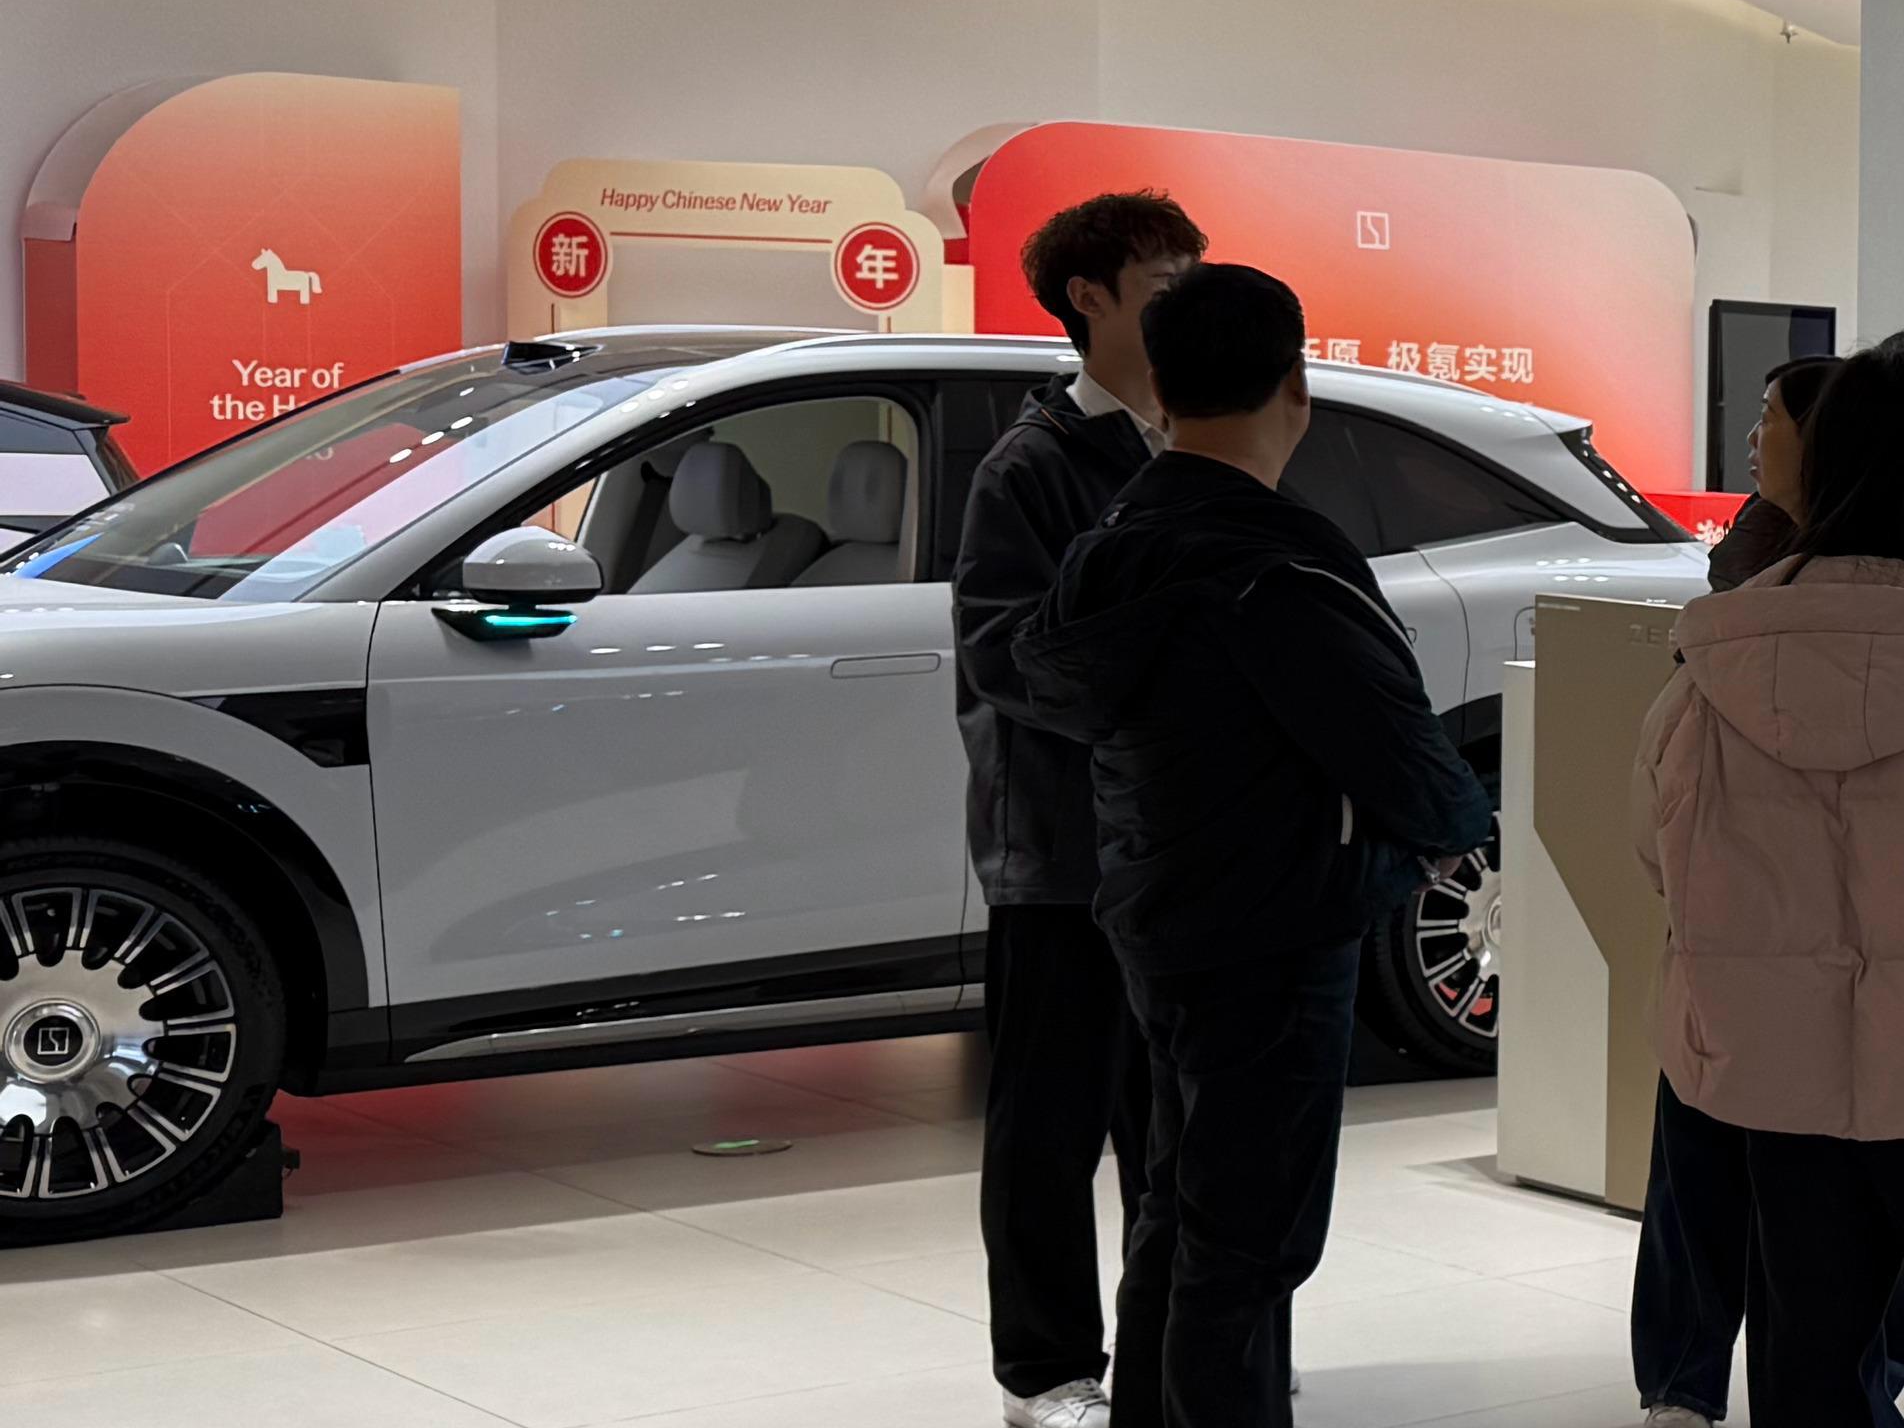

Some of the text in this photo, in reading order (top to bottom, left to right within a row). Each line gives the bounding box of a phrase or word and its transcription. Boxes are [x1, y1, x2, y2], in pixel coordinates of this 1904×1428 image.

[600, 188, 832, 215] Happy Chinese New Year
[550, 232, 590, 279] 新
[854, 243, 900, 290] 年
[231, 358, 345, 390] Year of
[1386, 339, 1536, 385] 极氪实现
[208, 392, 267, 422] the
